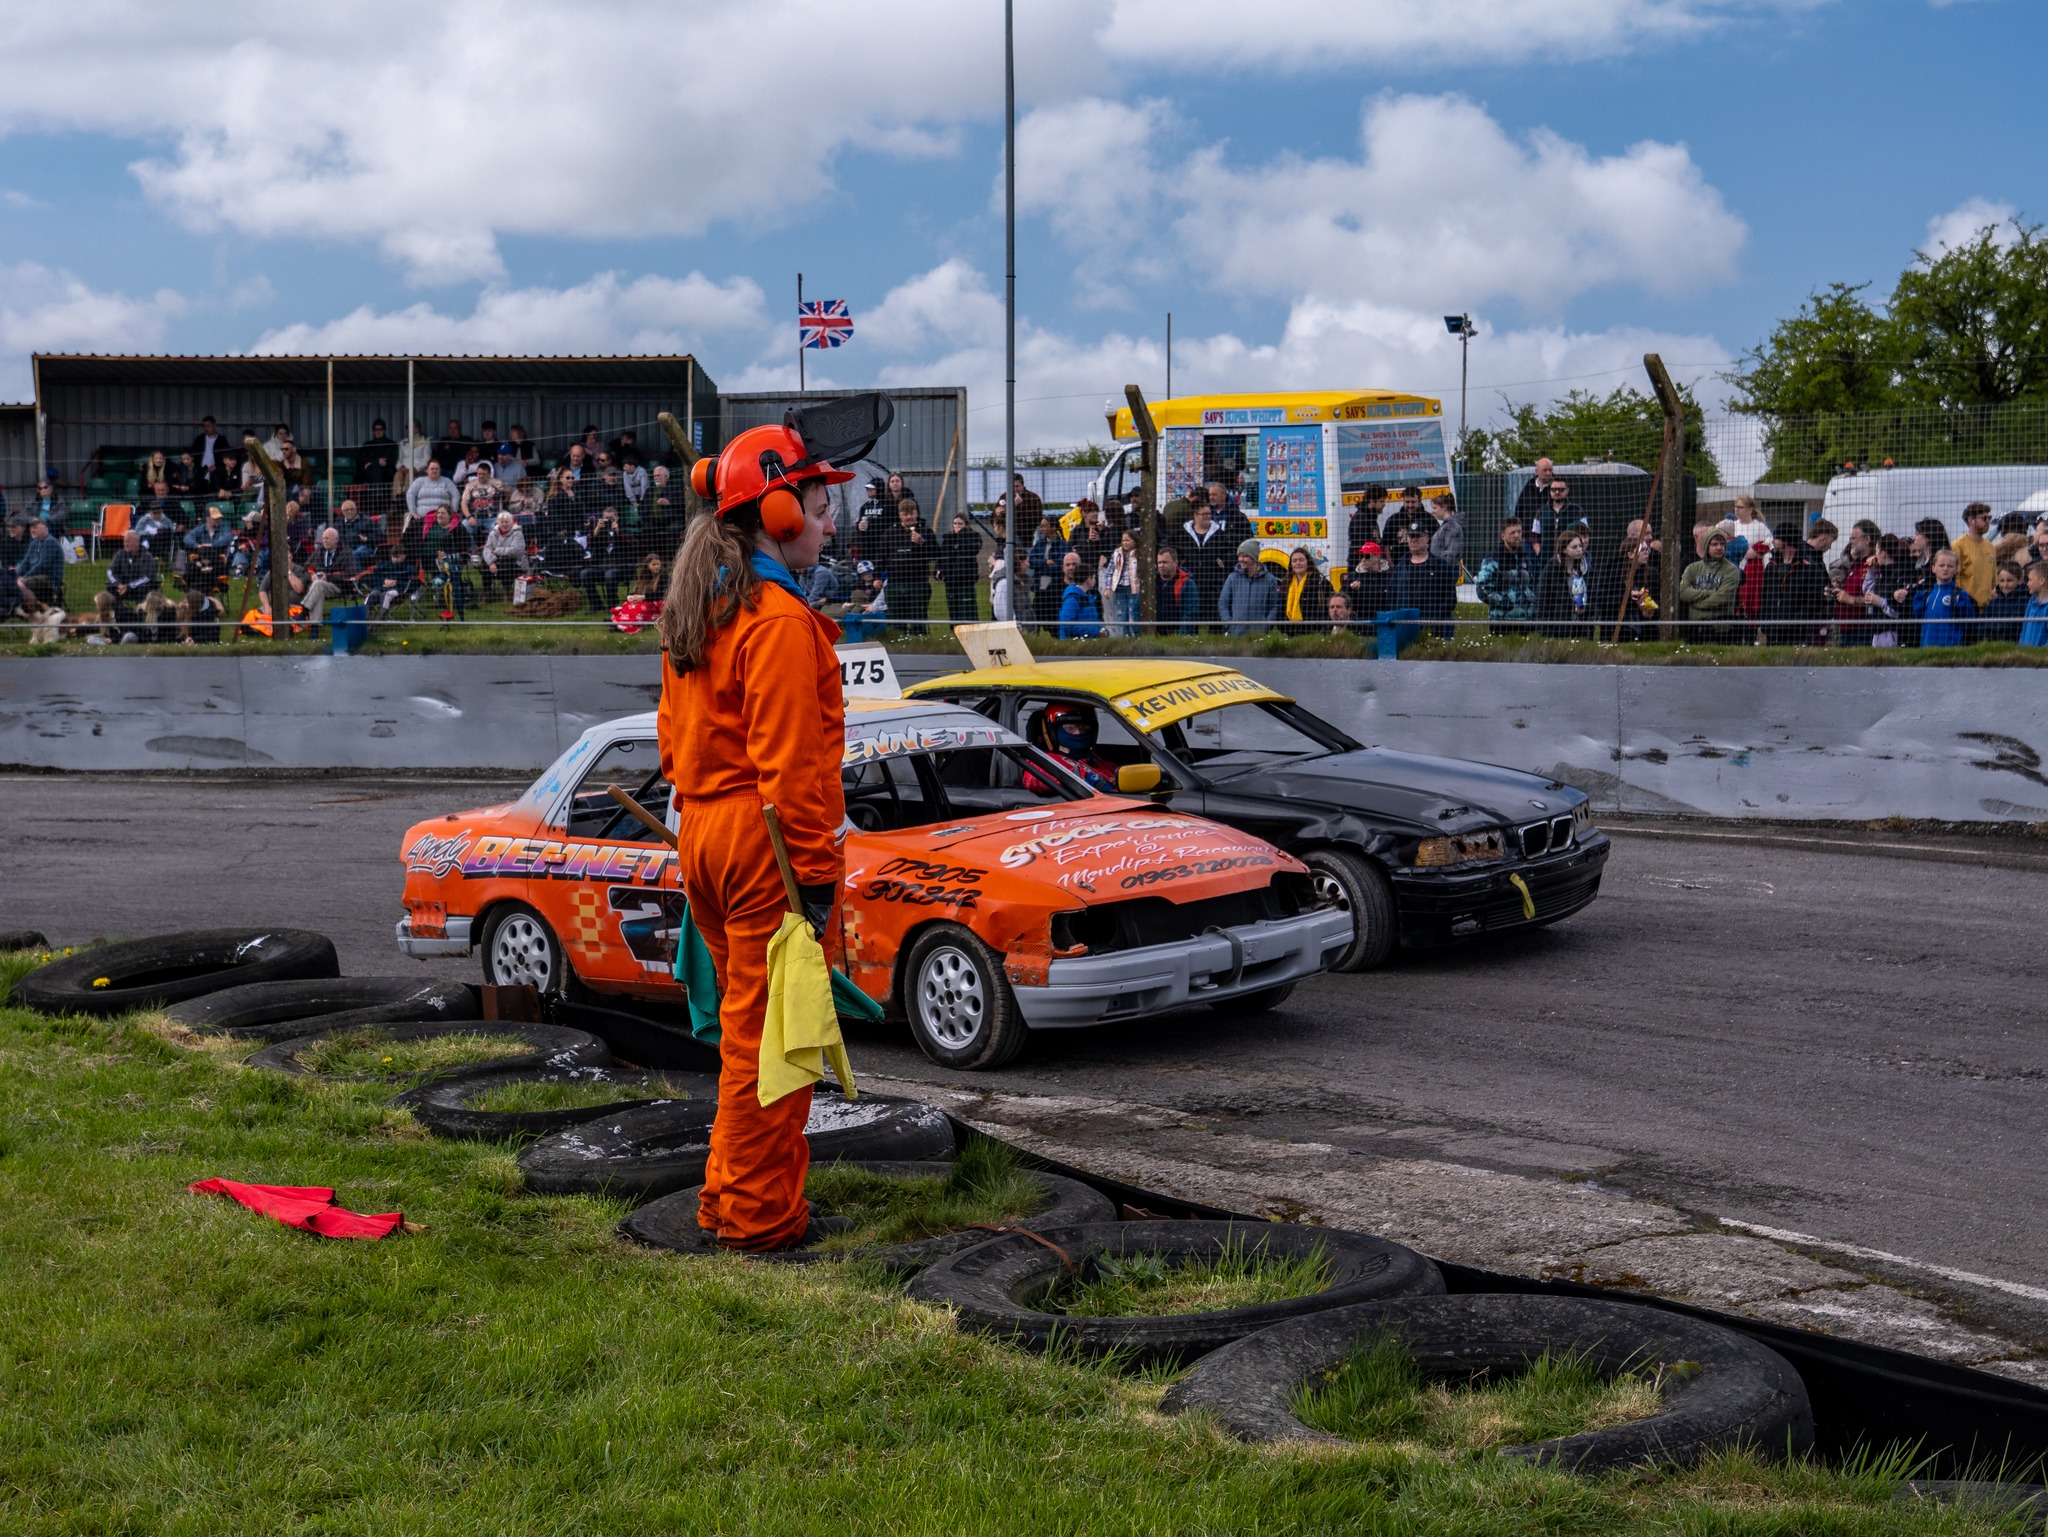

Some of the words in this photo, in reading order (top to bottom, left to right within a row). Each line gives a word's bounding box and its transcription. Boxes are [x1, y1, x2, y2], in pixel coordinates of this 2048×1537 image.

[1204, 410, 1224, 424] SAV'S
[1224, 410, 1249, 424] SUPER
[1249, 409, 1283, 423] WHIPPY
[1345, 405, 1366, 419] SAV'S
[1366, 403, 1392, 418] SUPER
[1392, 402, 1426, 416] WHIPPY
[1372, 431, 1391, 439] SHOWS
[1398, 430, 1419, 438] EVENTS
[1365, 452, 1389, 462] 07580
[1391, 450, 1420, 461] 382994
[1265, 521, 1310, 536] CREAM
[1133, 686, 1200, 718] KEVIN
[1197, 679, 1263, 697] OLIVER
[843, 725, 1004, 764] ENNETT
[1019, 819, 1095, 834] The
[406, 828, 472, 878] Andy
[1000, 821, 1127, 868] STOCK
[1050, 829, 1217, 865] Experience
[876, 857, 989, 884] 07905
[1057, 854, 1173, 887] Mendips
[1172, 845, 1270, 859] Raceway
[862, 879, 983, 909] 902842
